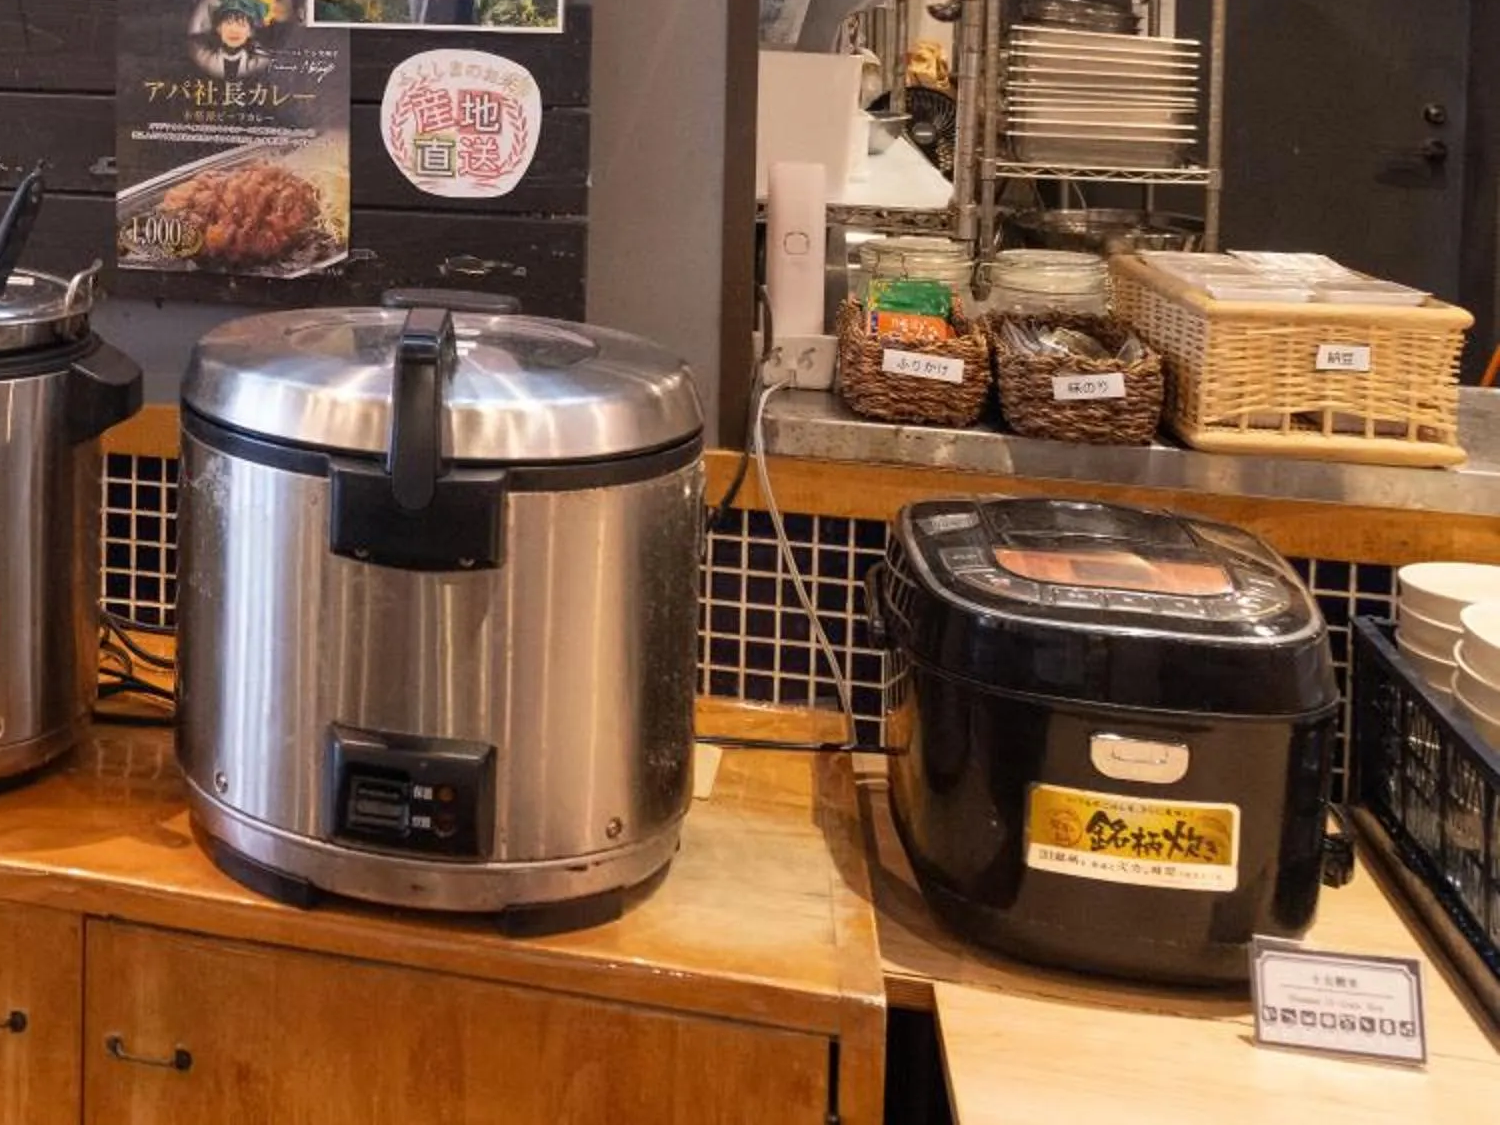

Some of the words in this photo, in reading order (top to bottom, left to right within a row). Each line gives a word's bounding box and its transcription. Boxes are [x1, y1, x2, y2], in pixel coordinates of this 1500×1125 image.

[144, 79, 316, 108] アパ社長カレー
[1085, 810, 1218, 863] 銘柄炊き
